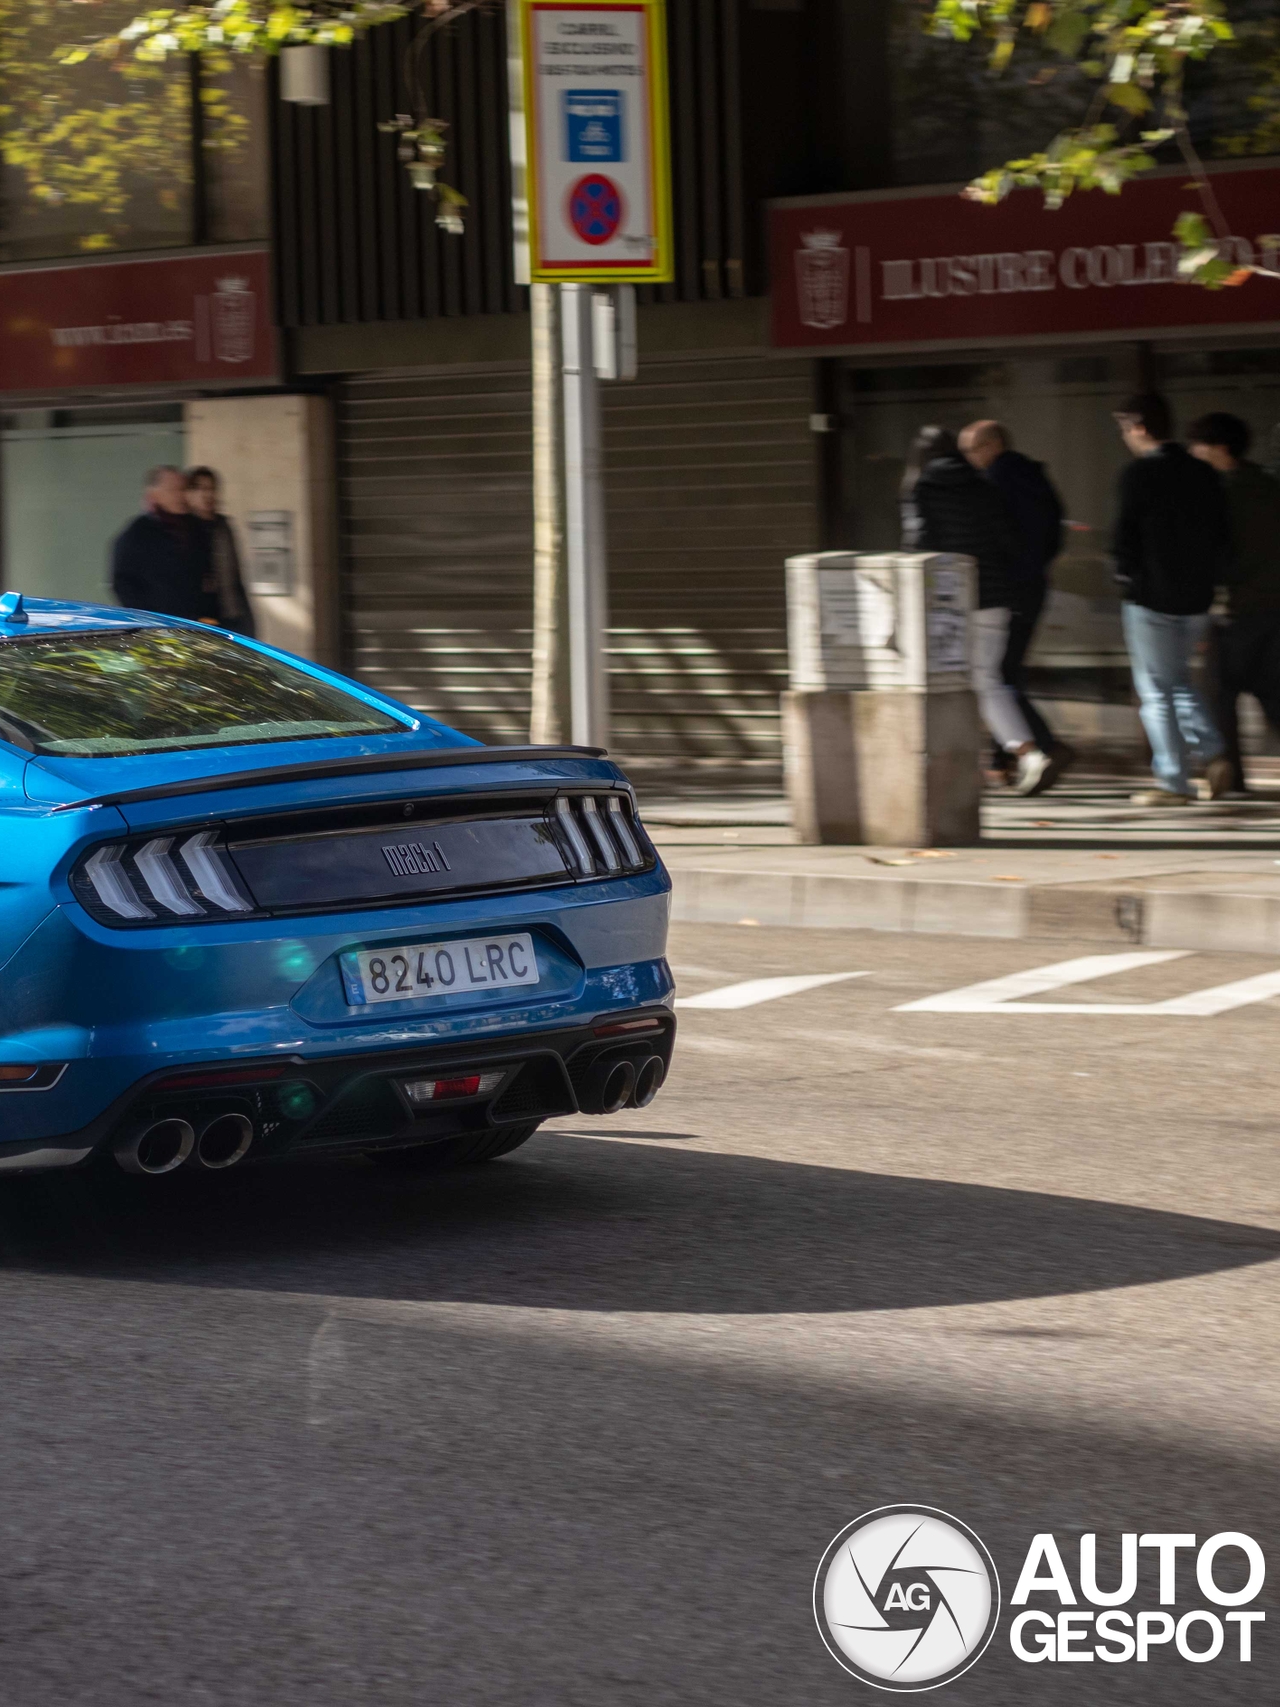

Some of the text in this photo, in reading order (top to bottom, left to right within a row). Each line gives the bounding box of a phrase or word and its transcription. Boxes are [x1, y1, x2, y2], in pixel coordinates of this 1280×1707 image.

[880, 249, 1056, 300] ILUSTRE
[434, 841, 451, 871] 1
[369, 941, 528, 994] 8240 LRC
